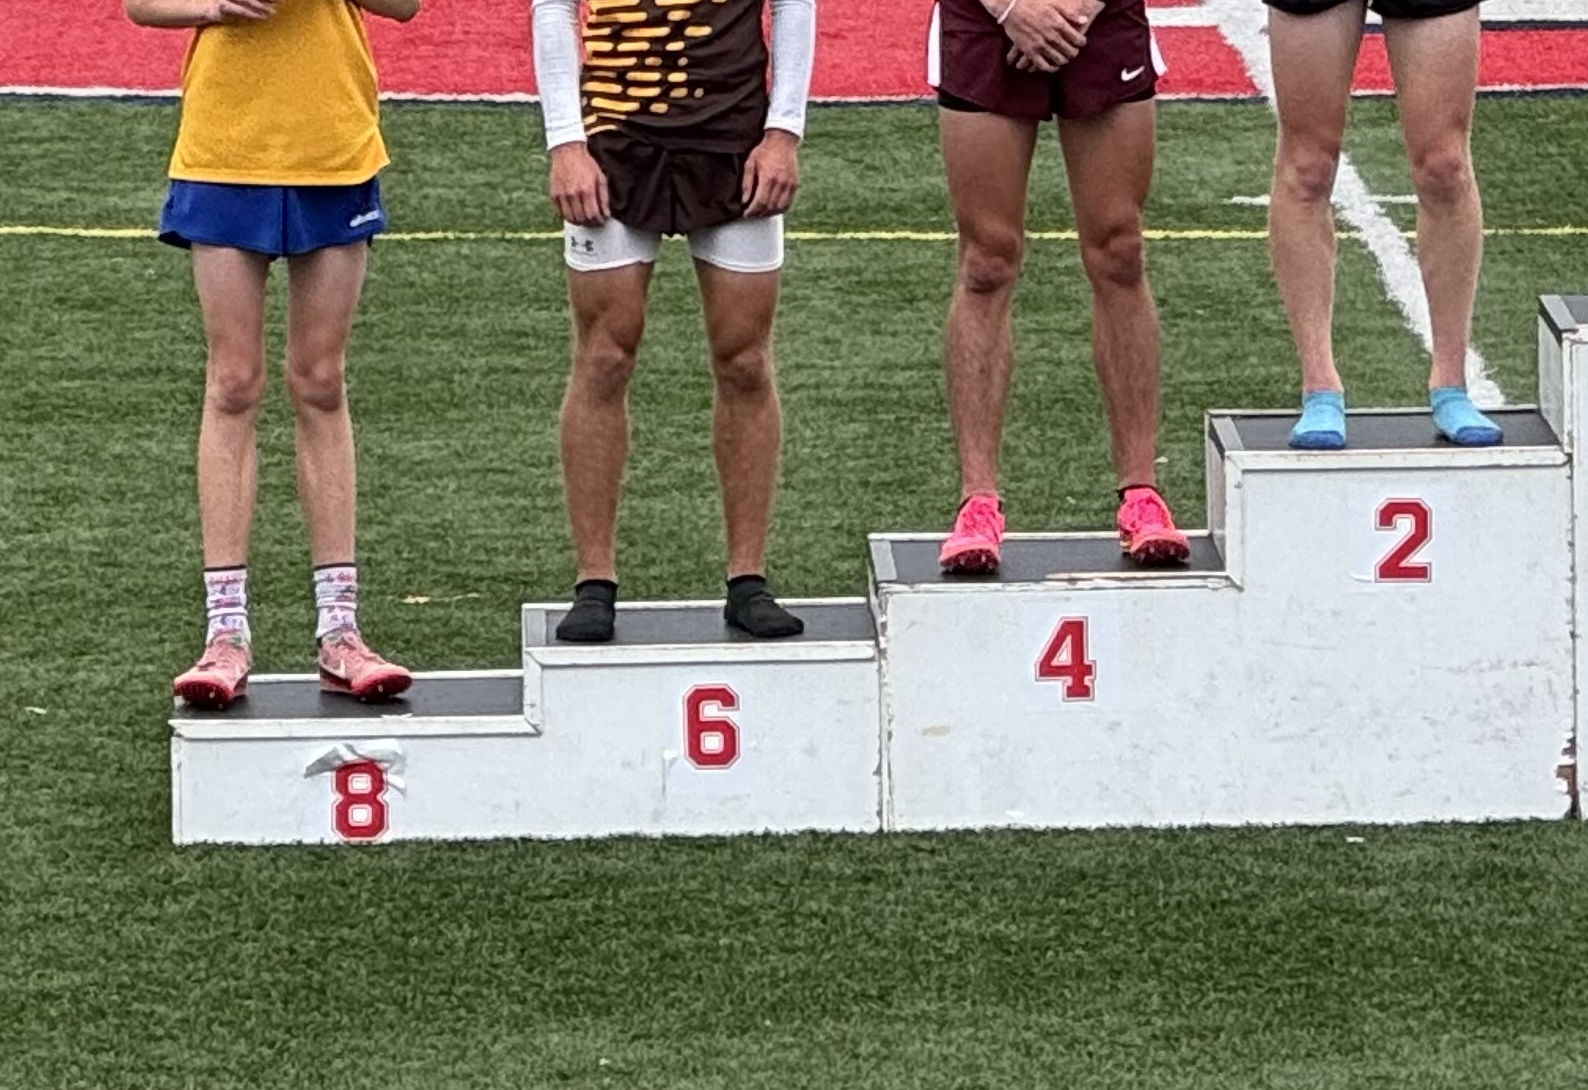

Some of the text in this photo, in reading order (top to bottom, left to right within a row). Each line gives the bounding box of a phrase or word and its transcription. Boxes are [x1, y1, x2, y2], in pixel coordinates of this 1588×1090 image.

[1374, 498, 1433, 583] 2
[1035, 616, 1097, 702] 4
[682, 683, 741, 770] 6
[331, 761, 390, 842] 8
